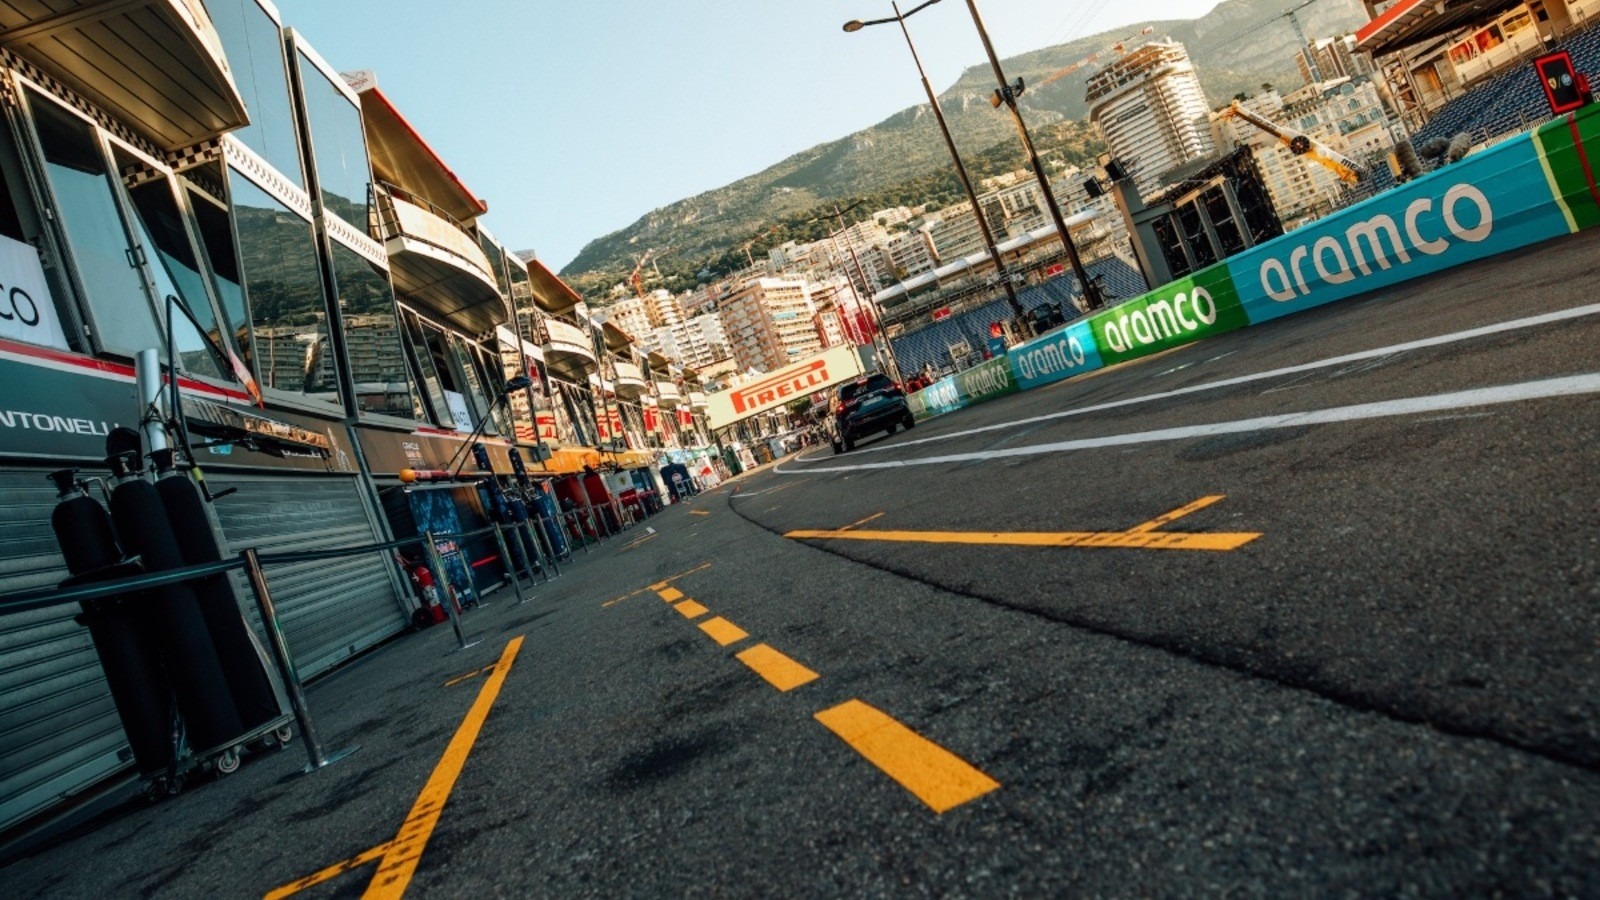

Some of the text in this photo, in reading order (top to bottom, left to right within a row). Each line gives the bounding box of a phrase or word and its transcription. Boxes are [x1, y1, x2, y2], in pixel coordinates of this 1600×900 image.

[1260, 183, 1493, 302] aramco
[1104, 286, 1216, 353] aramco
[964, 365, 1009, 399] aramco
[1018, 336, 1085, 380] aramco
[730, 359, 829, 415] PIRELLI
[0, 410, 119, 436] NTONELL
